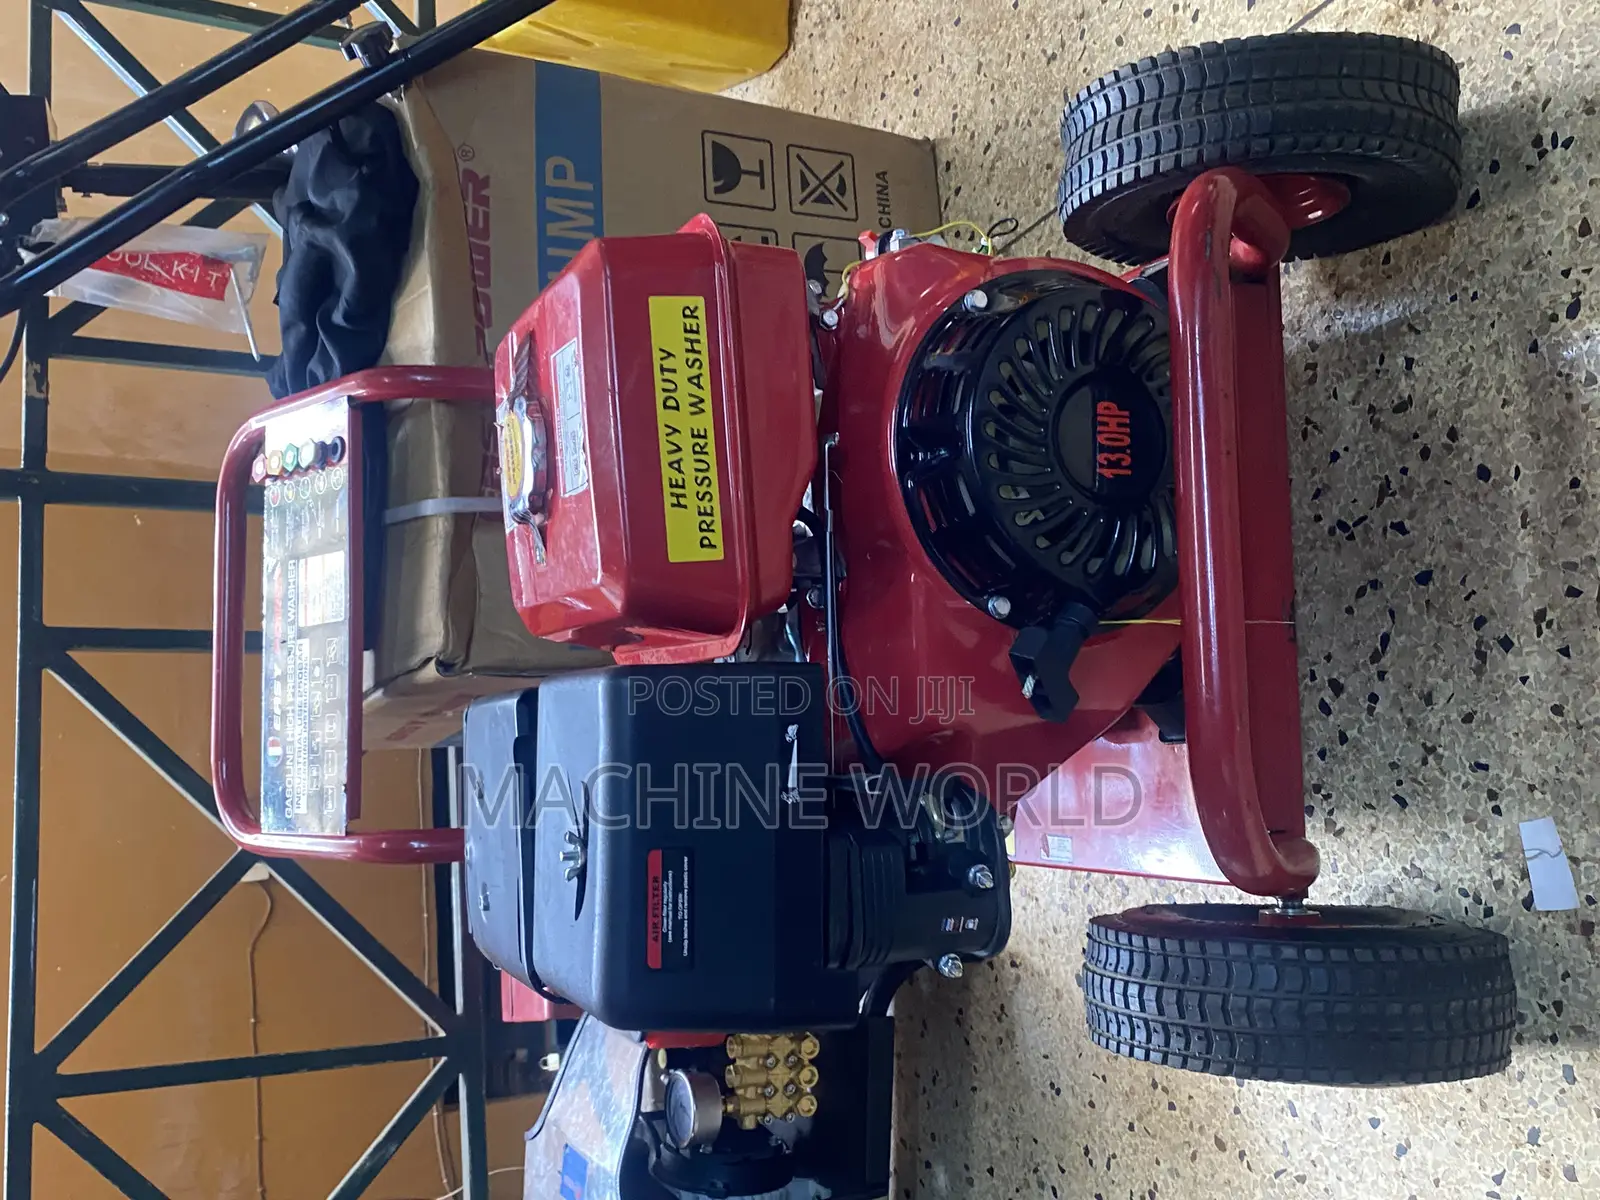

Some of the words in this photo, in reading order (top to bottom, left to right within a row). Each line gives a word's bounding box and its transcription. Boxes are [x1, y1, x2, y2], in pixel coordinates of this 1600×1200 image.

[875, 170, 892, 229] CHINA
[658, 347, 680, 412] DUTY
[682, 305, 706, 416] WASHER
[664, 423, 688, 510] HEAVY
[1096, 401, 1132, 479] 13.0HP
[690, 427, 717, 550] PRESSURE
[288, 560, 296, 624] WASHER
[273, 663, 282, 731] EASY
[287, 625, 296, 702] PRESSURE
[286, 706, 295, 741] HIGH
[284, 745, 294, 818] GASOLINE
[652, 876, 660, 919] FILTER
[652, 921, 660, 942] AIR
